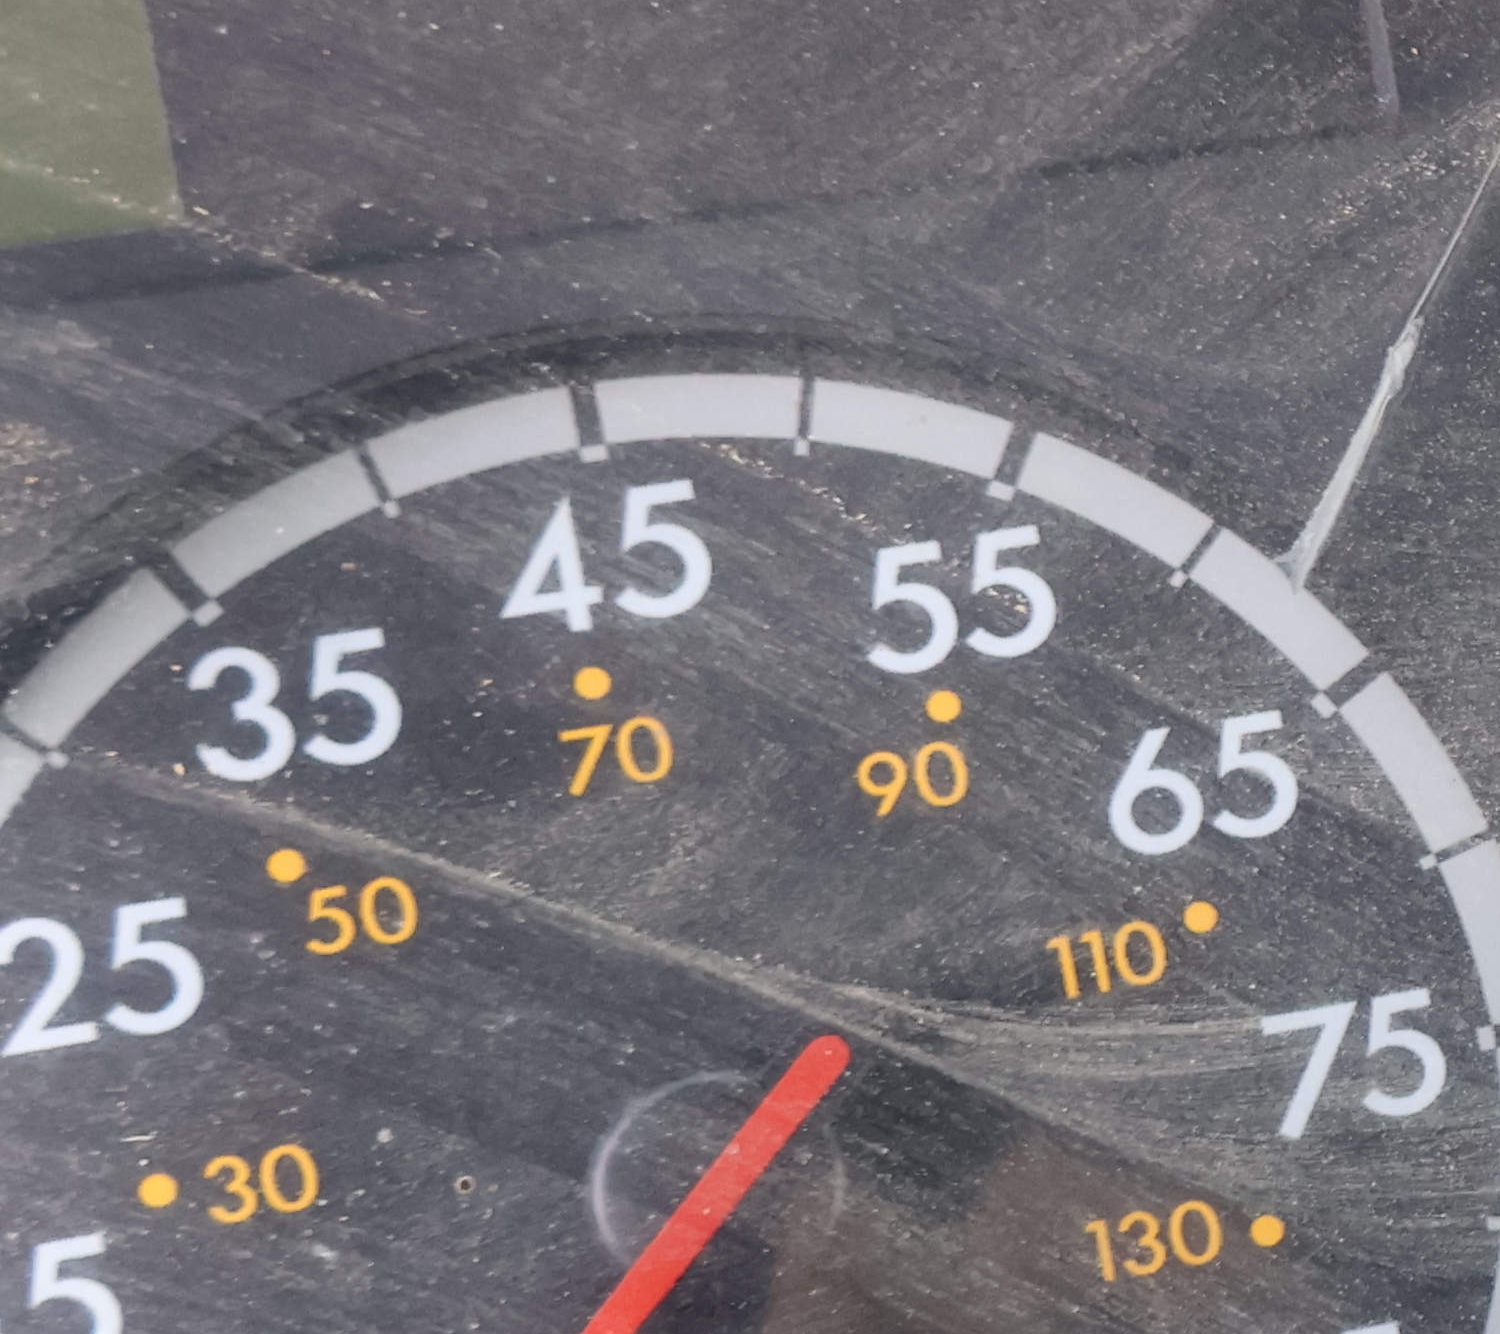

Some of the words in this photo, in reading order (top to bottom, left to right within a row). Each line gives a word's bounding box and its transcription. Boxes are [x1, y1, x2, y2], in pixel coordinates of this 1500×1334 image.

[499, 479, 712, 633] 45
[866, 524, 1057, 674] 55
[187, 628, 401, 781] 35
[559, 716, 674, 796] 70
[856, 741, 970, 817] 90
[1108, 709, 1299, 856] 65
[305, 877, 418, 955] 50
[1047, 920, 1167, 998] 110
[0, 897, 204, 1056] 25
[1261, 988, 1447, 1141] 75
[204, 1144, 319, 1224] 30
[1085, 1200, 1223, 1281] 130
